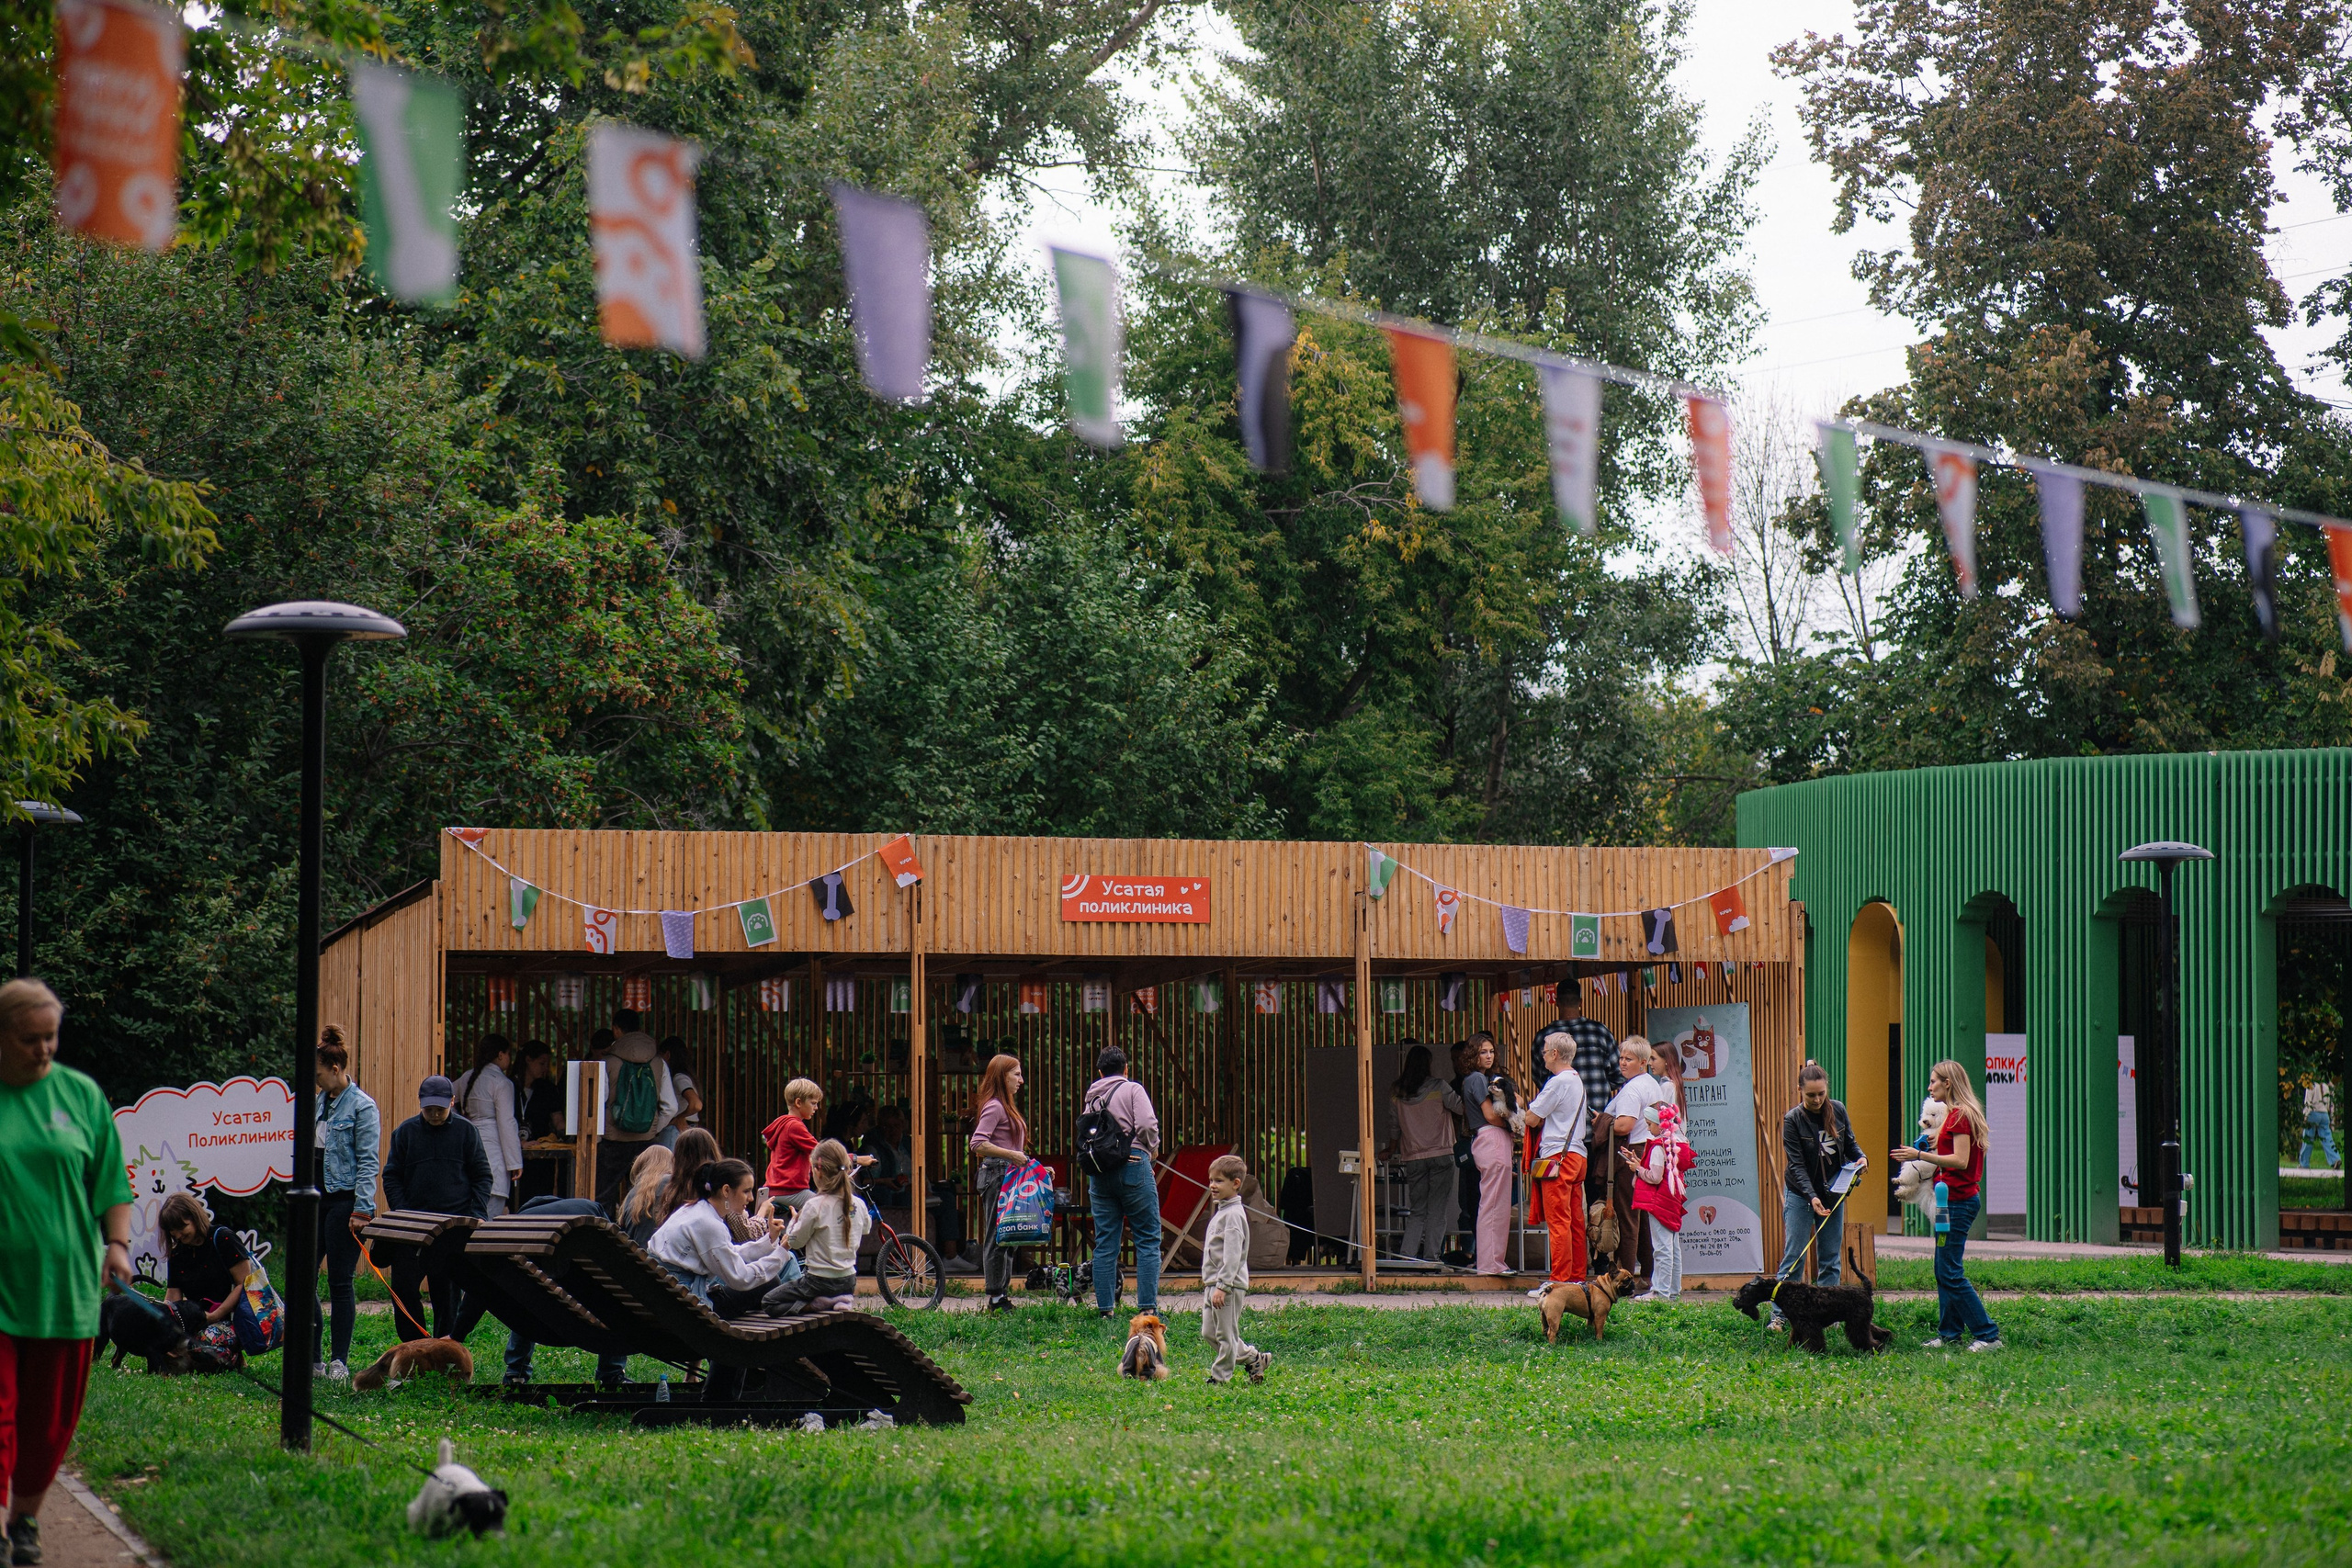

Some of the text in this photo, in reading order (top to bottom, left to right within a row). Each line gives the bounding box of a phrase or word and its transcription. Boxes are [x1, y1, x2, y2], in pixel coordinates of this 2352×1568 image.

[1102, 880, 1165, 897] Усатая
[1080, 901, 1193, 915] поликлиника
[1985, 1056, 2015, 1070] апки
[1684, 1085, 1726, 1102] ЕТГАРАНТ
[212, 1111, 272, 1126] Усатая
[1686, 1119, 1716, 1128] РАПИЯ
[188, 1129, 295, 1148] Поликлиника
[1685, 1129, 1718, 1138] ИРУРГИЯ
[1693, 1157, 1736, 1167] ИРОВАНИЕ
[1684, 1178, 1745, 1188] ЫЗОВ НА ДОМ
[998, 1223, 1039, 1234] ozon банк
[1686, 1229, 1707, 1237] работы
